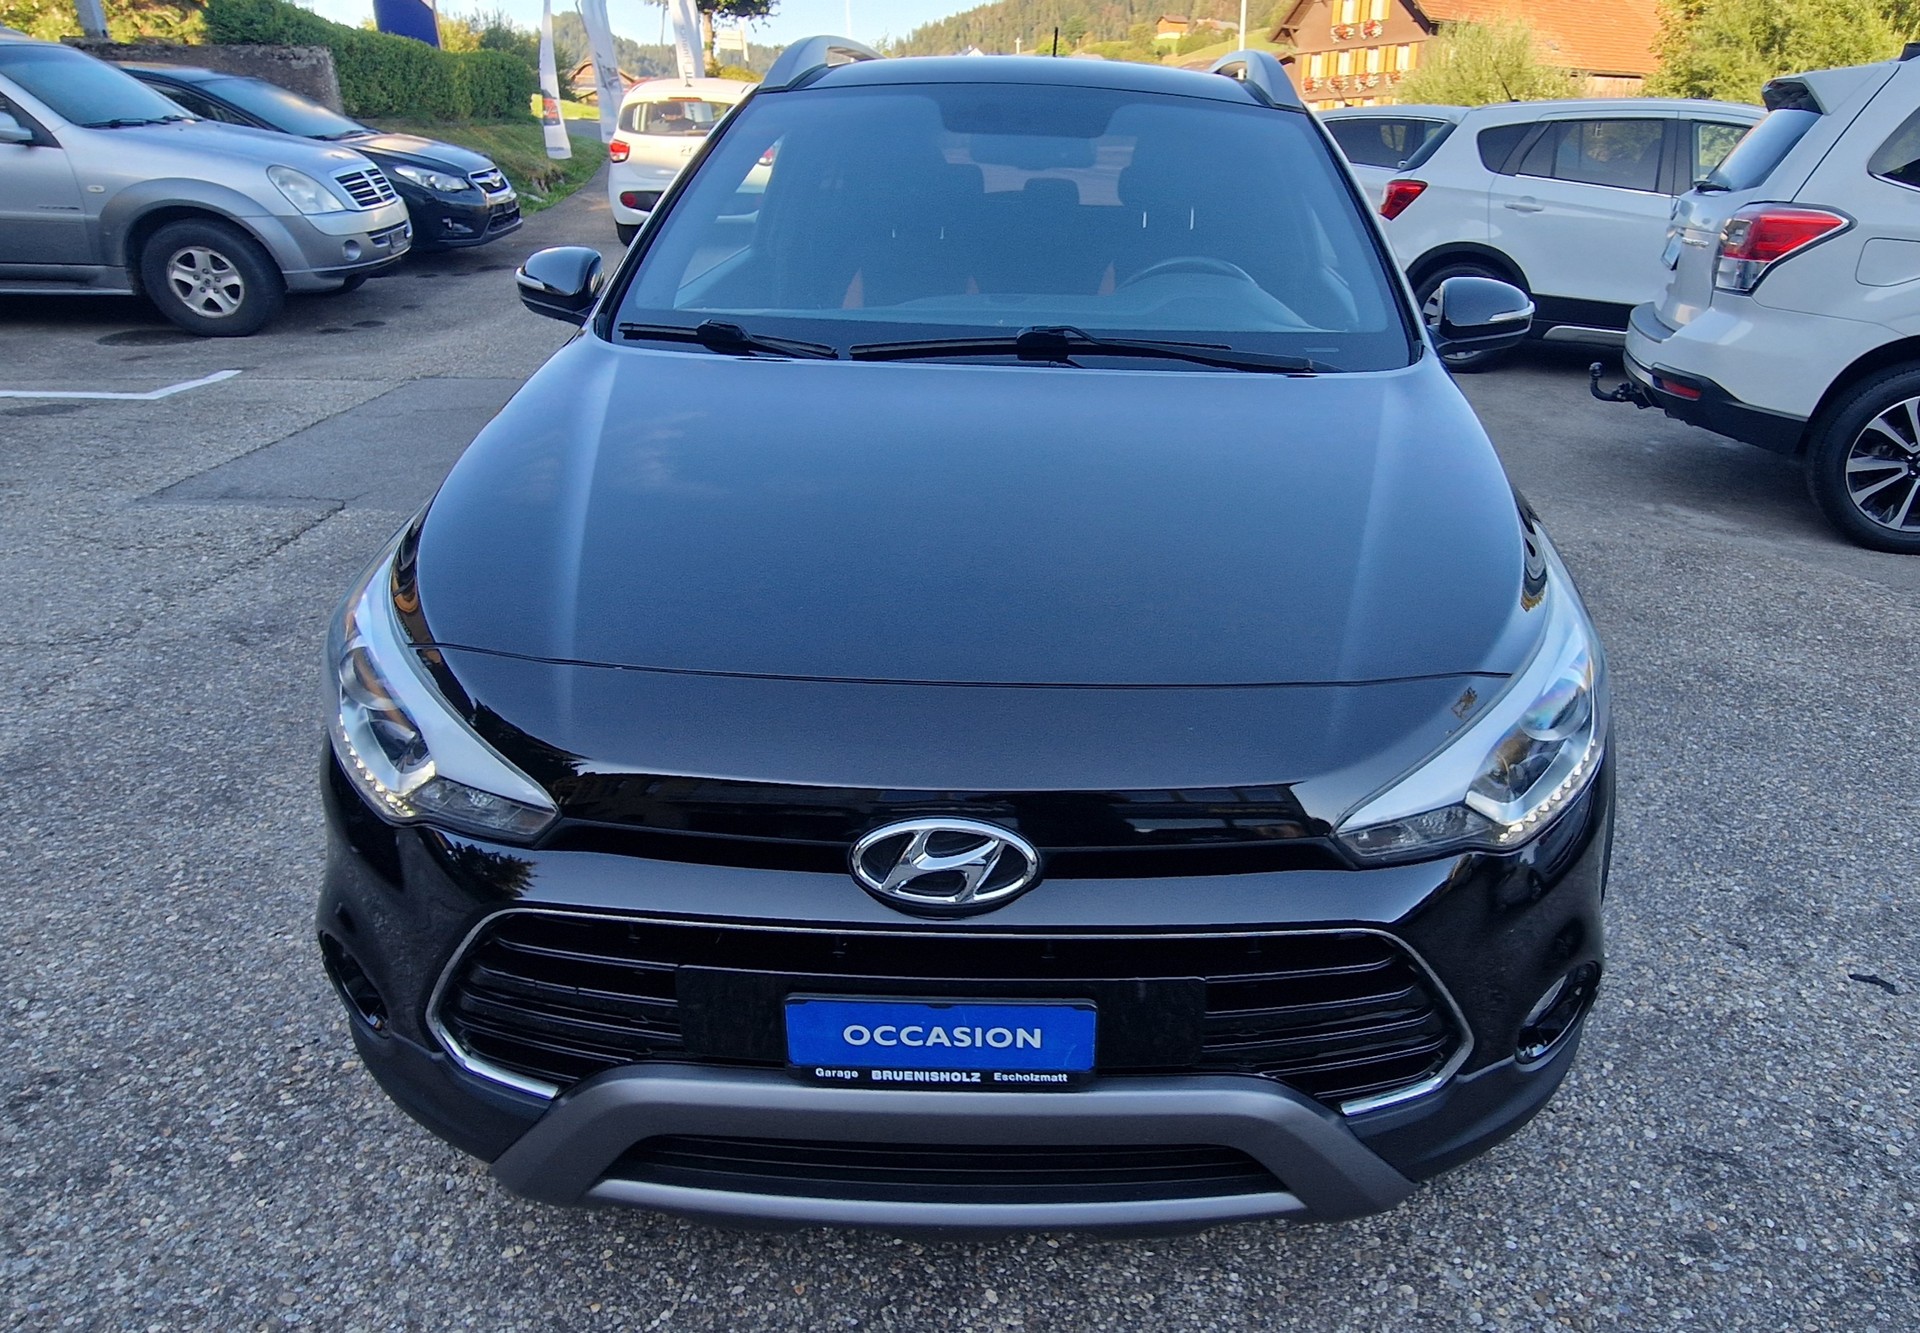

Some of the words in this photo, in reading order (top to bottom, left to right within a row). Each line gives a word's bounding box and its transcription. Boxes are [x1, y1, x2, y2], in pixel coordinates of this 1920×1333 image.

[843, 1025, 1042, 1049] OCCASION
[815, 1067, 859, 1079] Garage
[871, 1069, 981, 1083] BRUENISHOLZ
[993, 1072, 1068, 1083] Escholzmatt
